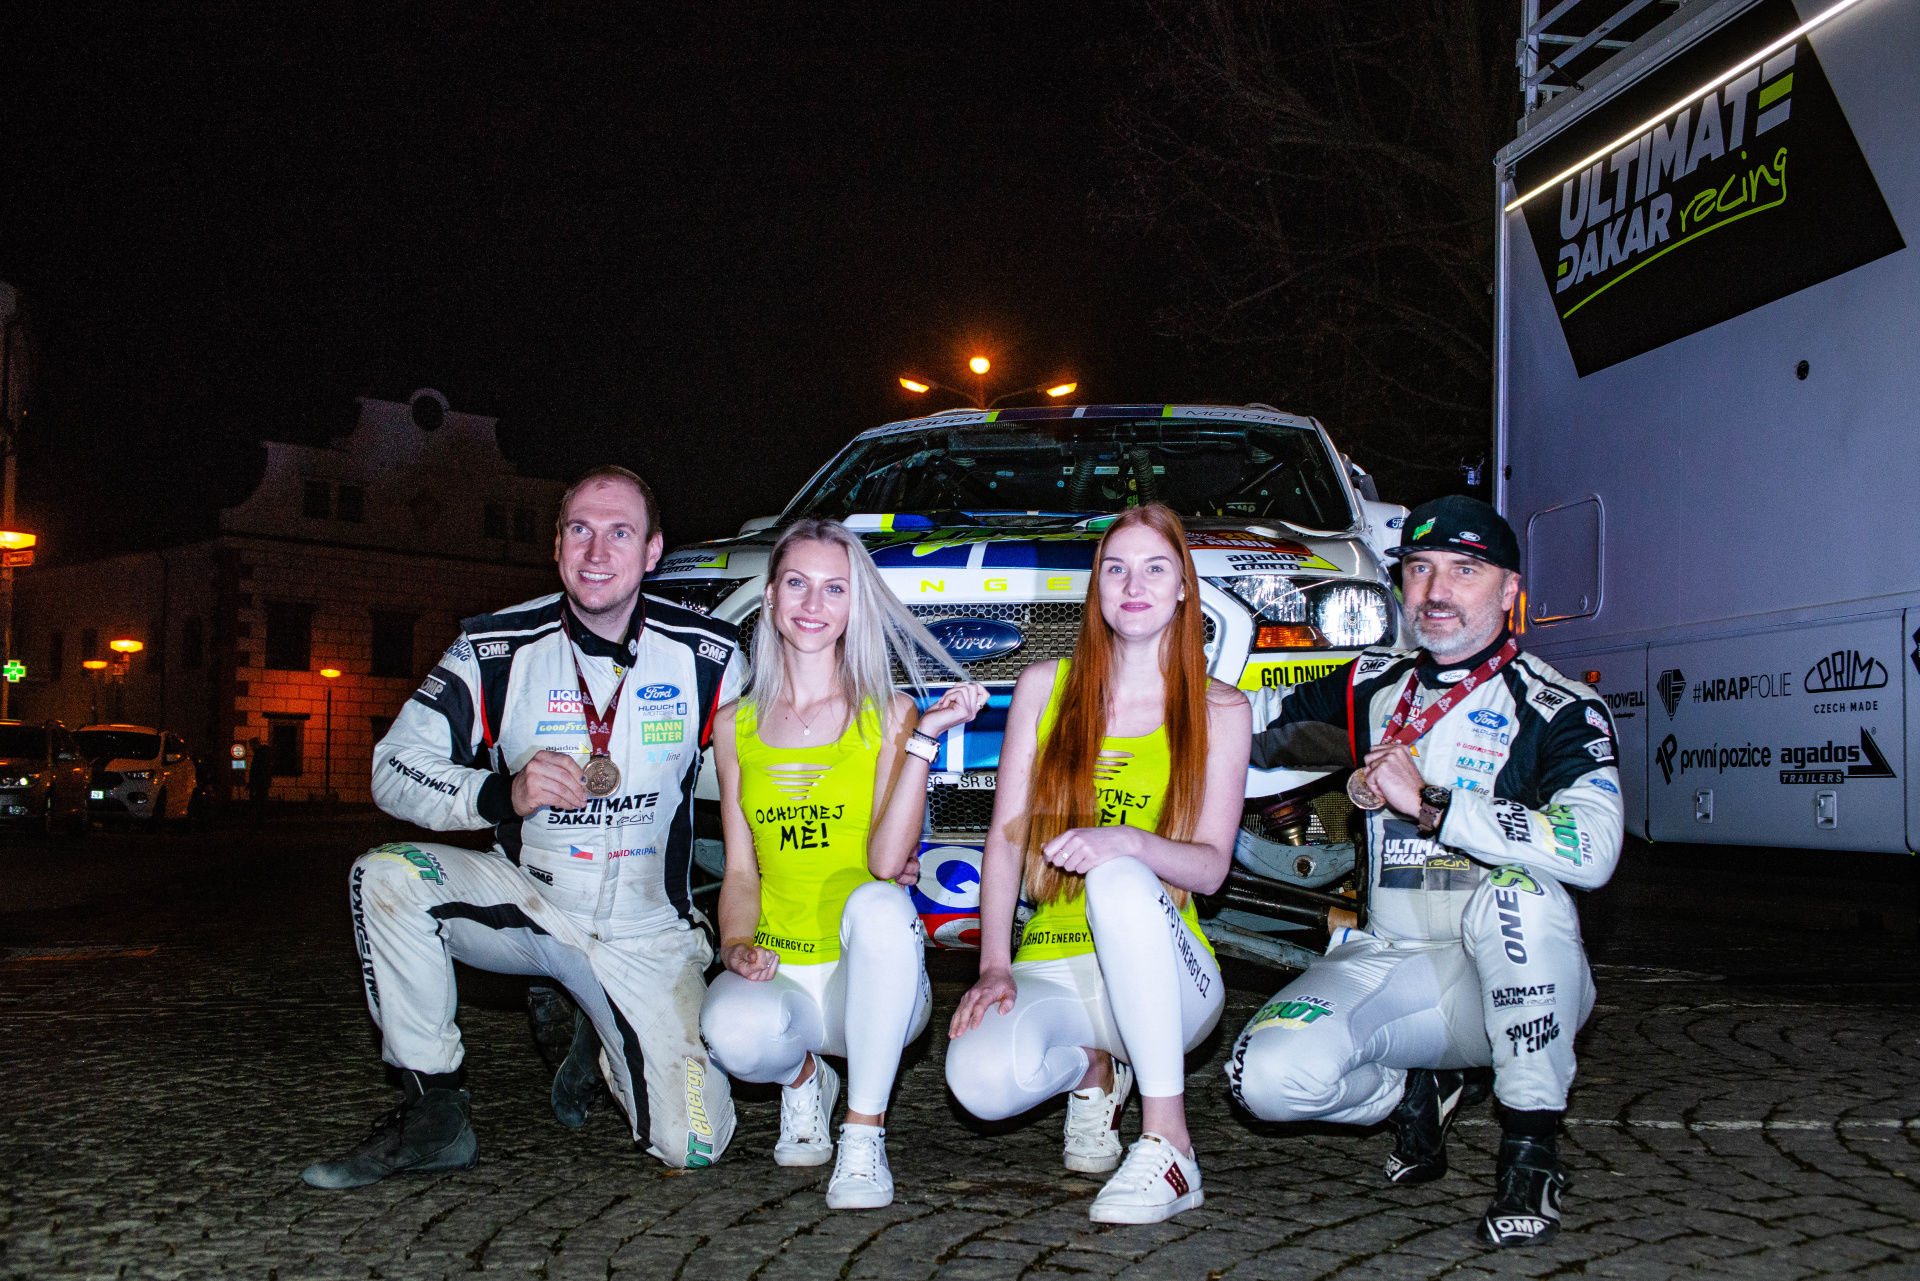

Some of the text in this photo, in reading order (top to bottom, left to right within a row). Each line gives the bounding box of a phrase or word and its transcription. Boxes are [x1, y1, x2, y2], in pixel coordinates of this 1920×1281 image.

[1559, 43, 1798, 241] ULTIMATE
[1556, 147, 1788, 294] DAKAR racing
[1185, 409, 1297, 425] MOTORS
[1225, 552, 1308, 563] agados
[934, 623, 997, 650] Ford
[478, 643, 510, 657] OMP
[698, 642, 728, 661] OMP
[1359, 660, 1386, 672] OMP
[1816, 650, 1876, 690] PRIM
[420, 678, 444, 696] OMP
[643, 685, 673, 699] Ford
[1692, 672, 1792, 704] #WRAPFOLIE
[549, 690, 582, 702] LIQU
[1535, 690, 1564, 708] OMP
[549, 702, 584, 713] MOLY
[638, 704, 675, 712] HLOUCH
[1813, 700, 1879, 714] CZECH MADE
[539, 722, 587, 733] GOODYEA
[643, 721, 683, 732] MANN
[1474, 710, 1501, 729] Ford
[643, 731, 683, 743] FILTER
[1719, 742, 1772, 775] pozice
[1781, 741, 1861, 769] agados
[960, 775, 980, 789] SR
[1782, 773, 1843, 783] TRAILERS
[547, 810, 655, 826] DAKAR racing
[755, 804, 845, 824] OCHUTNEJ
[1508, 799, 1532, 844] OUTH
[779, 820, 830, 851] MĚ!
[1385, 839, 1450, 856] ULTIMA
[1580, 831, 1593, 865] ONE
[425, 851, 450, 882] ONE
[1383, 853, 1470, 869] DAKAR racing
[352, 865, 369, 939] DAKAR
[1495, 889, 1528, 965] ONE
[1492, 984, 1555, 999] ULTIMATE
[1296, 995, 1335, 1009] ONE
[1494, 997, 1524, 1008] DAKAR
[1506, 1011, 1554, 1042] SOUTH
[1232, 1034, 1253, 1096] AKAR
[686, 1058, 713, 1136] energy
[1495, 1219, 1545, 1235] OMP
